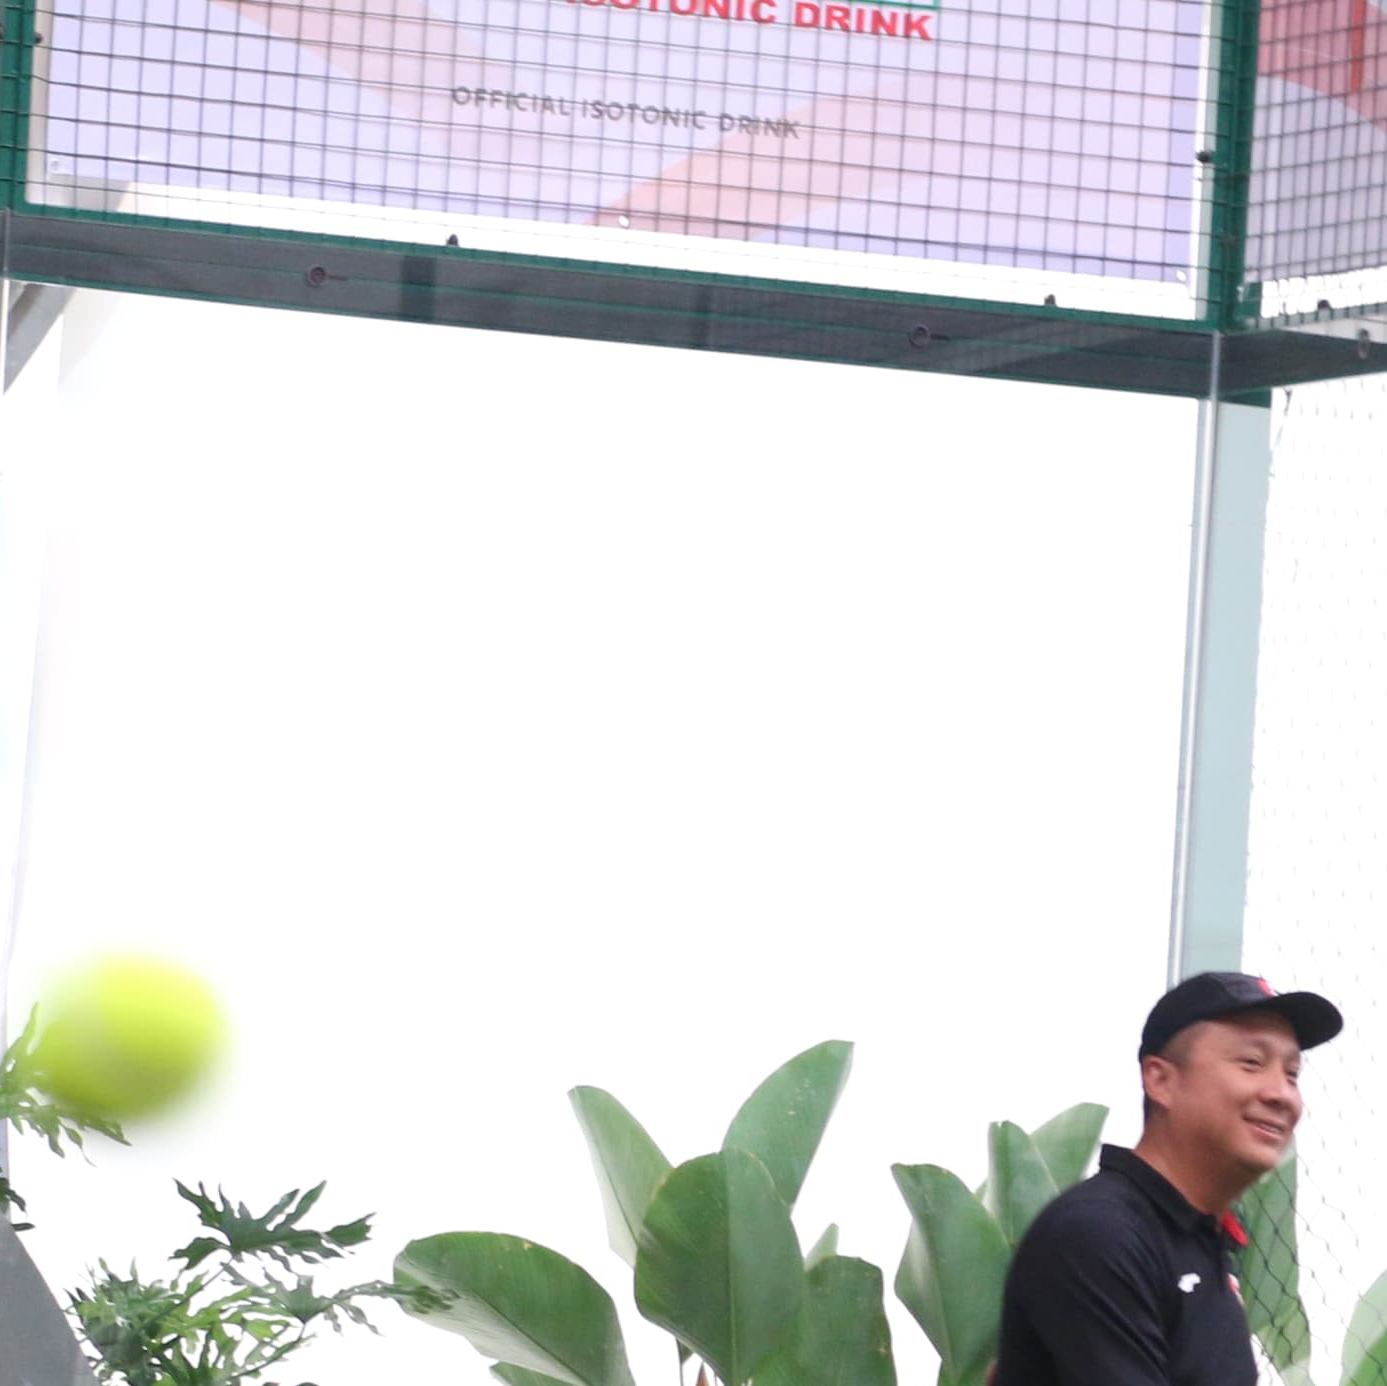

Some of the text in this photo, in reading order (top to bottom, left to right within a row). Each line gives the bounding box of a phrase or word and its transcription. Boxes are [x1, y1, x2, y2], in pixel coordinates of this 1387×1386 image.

[793, 2, 931, 40] DRINK
[452, 85, 801, 140] OFFICIAL ISOTONIC DRINK
